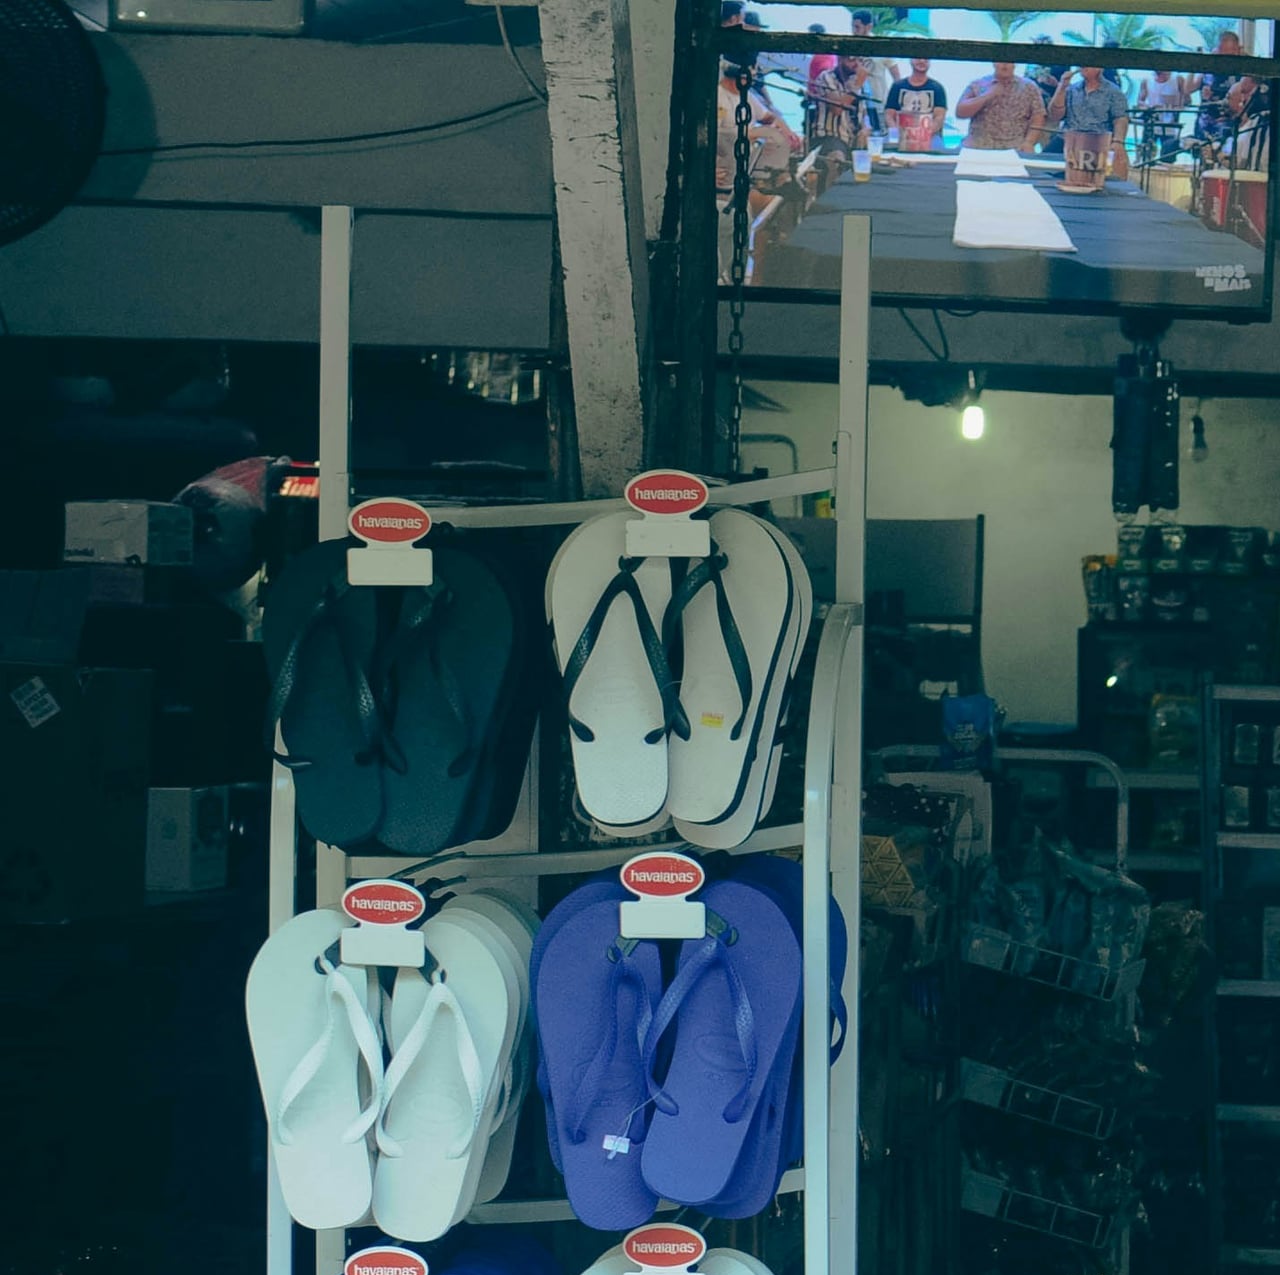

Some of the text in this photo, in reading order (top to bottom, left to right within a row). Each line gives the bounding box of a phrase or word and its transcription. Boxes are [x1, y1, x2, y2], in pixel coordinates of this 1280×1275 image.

[635, 489, 697, 504] havaianas
[359, 516, 422, 533] havaianas
[630, 869, 695, 885] havaianas
[351, 897, 414, 914] havaianas
[632, 1240, 694, 1256] havaianas
